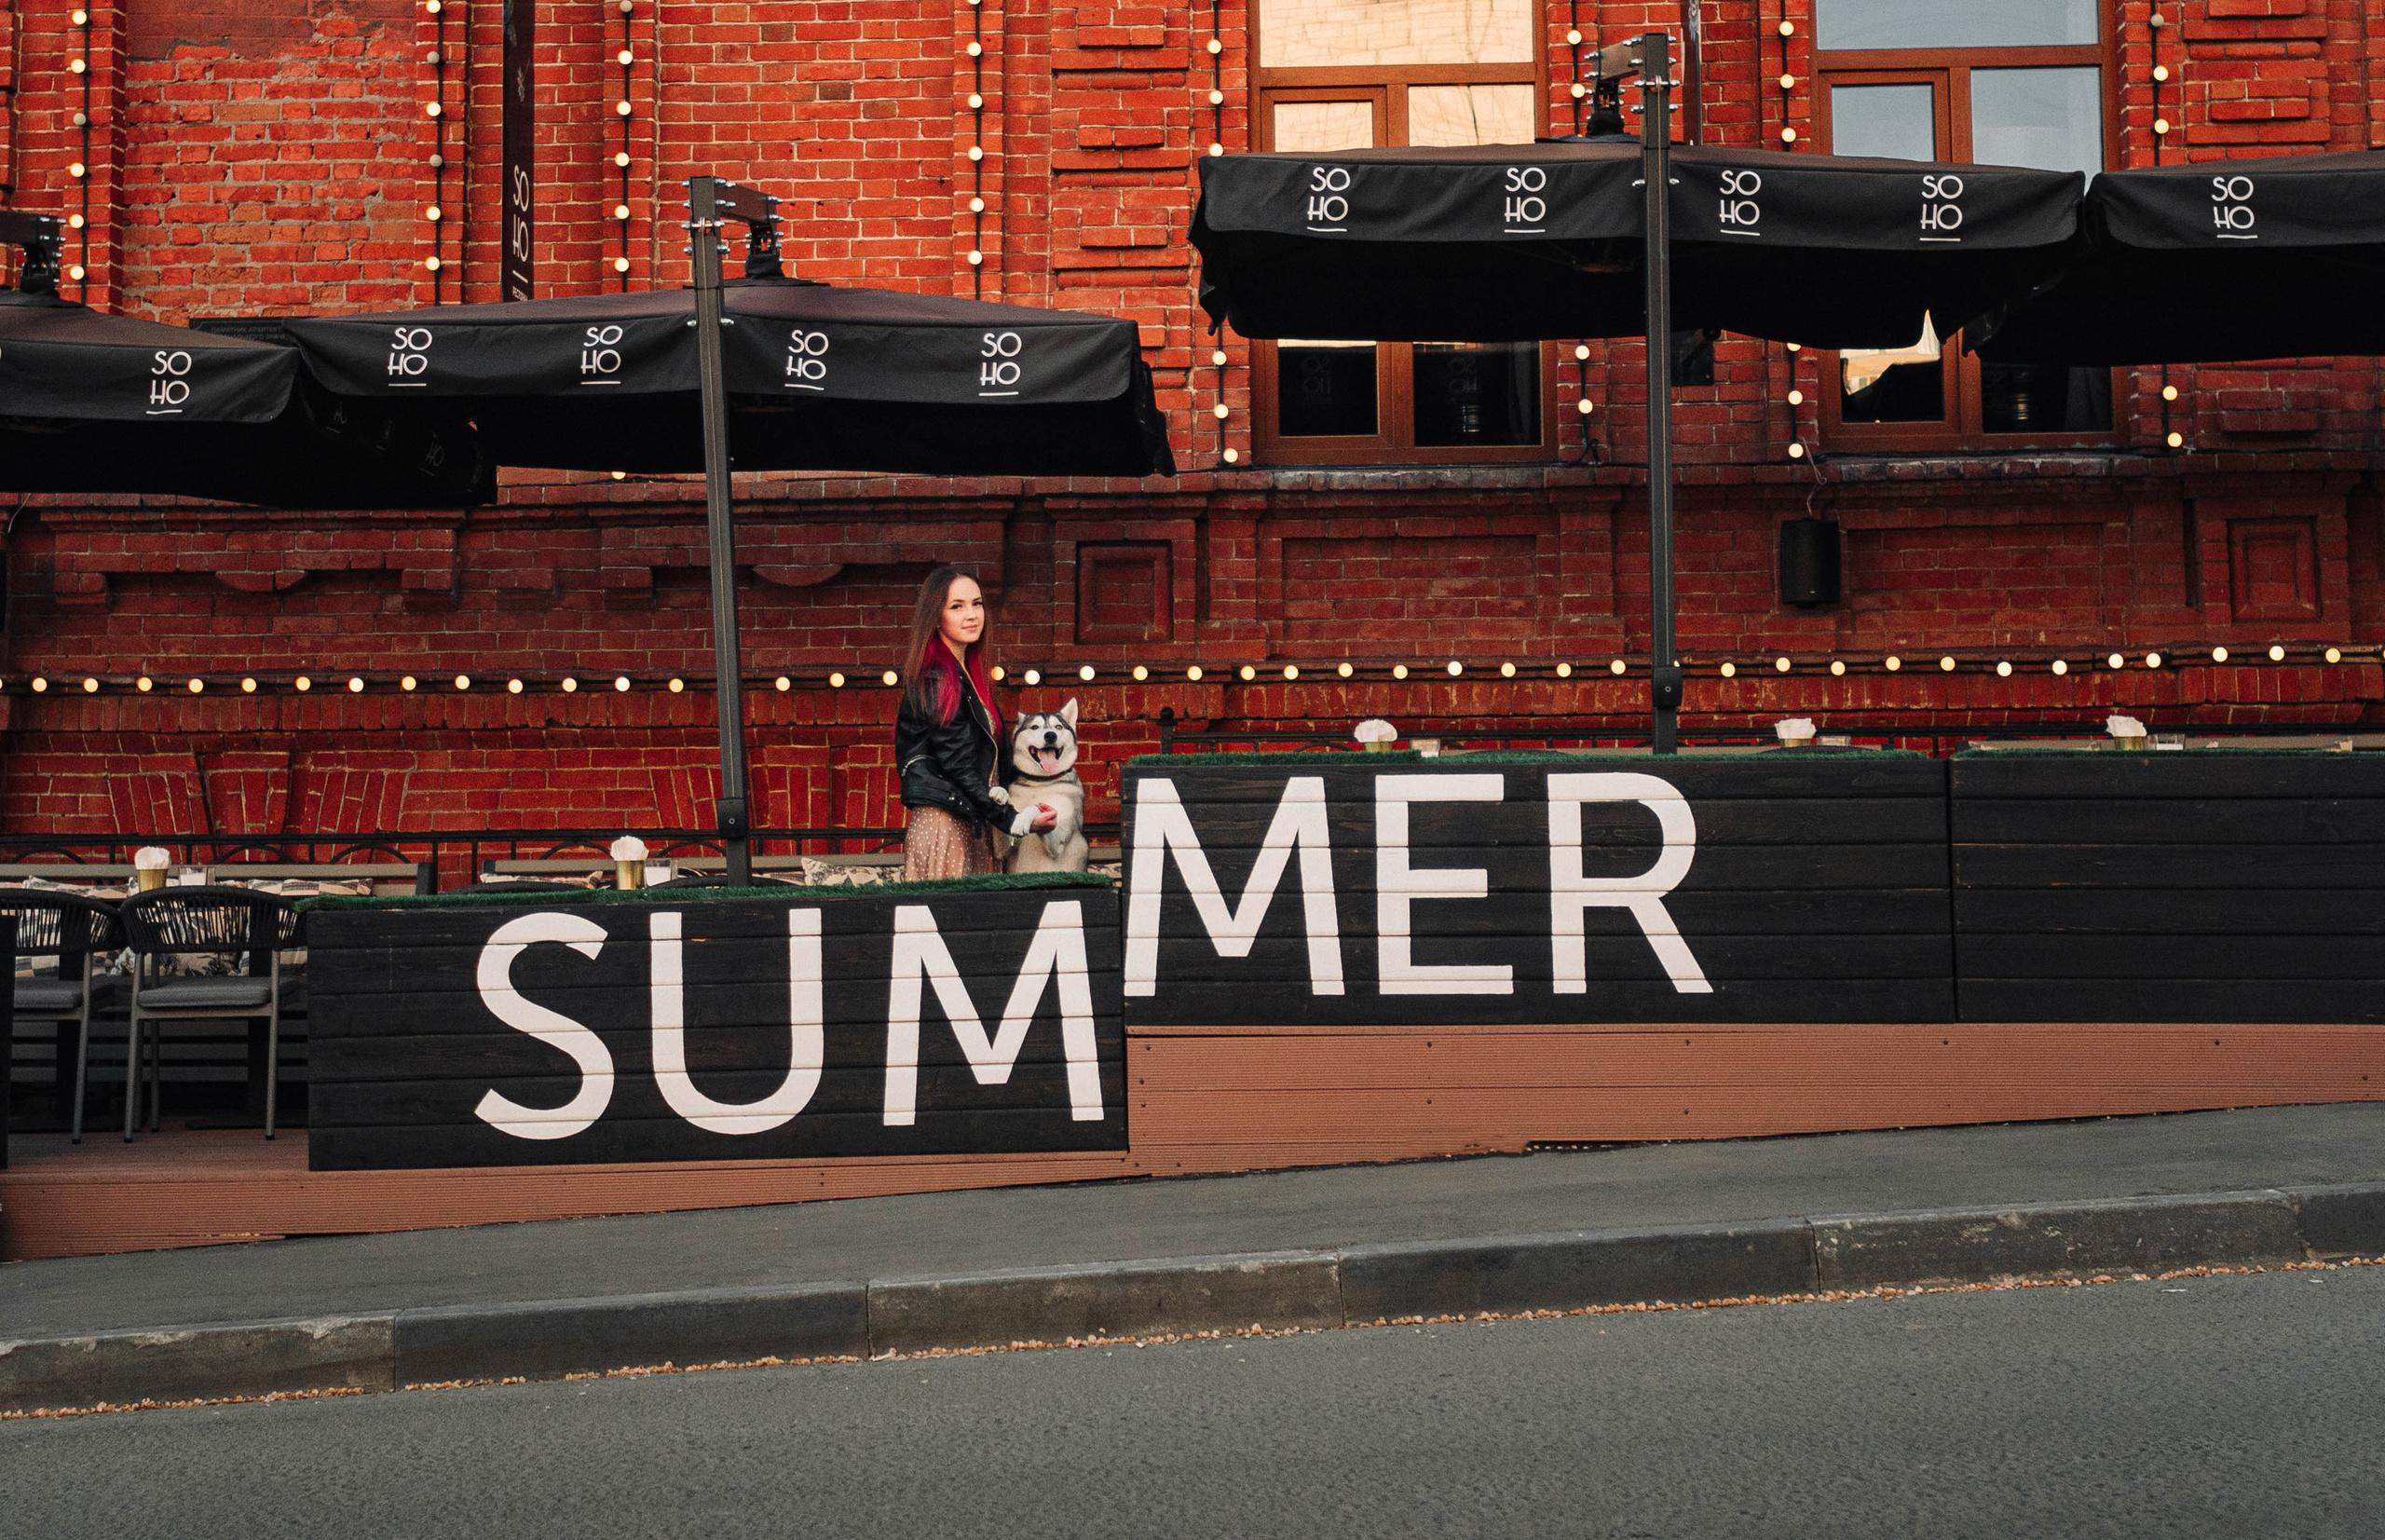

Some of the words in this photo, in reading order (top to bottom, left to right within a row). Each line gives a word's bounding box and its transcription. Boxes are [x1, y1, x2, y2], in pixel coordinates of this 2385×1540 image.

[512, 164, 529, 212] SO
[1310, 167, 1351, 192] SO
[1505, 168, 1547, 192] SO
[1719, 170, 1762, 196] SO
[1921, 174, 1964, 199] SO
[2211, 176, 2255, 201] SO
[1307, 196, 1349, 222] HO
[1505, 197, 1547, 222] HO
[1719, 199, 1760, 225] HO
[1920, 203, 1963, 229] HO
[2213, 205, 2255, 229] HO
[512, 213, 529, 263] HO
[390, 326, 433, 350] SO
[584, 325, 623, 348] SO
[788, 329, 829, 356] SO
[981, 332, 1022, 358] SO
[151, 350, 192, 375] SO
[388, 352, 429, 375] HO
[581, 348, 621, 374] HO
[785, 356, 827, 380] HO
[980, 361, 1021, 386] HO
[150, 379, 190, 404] HO
